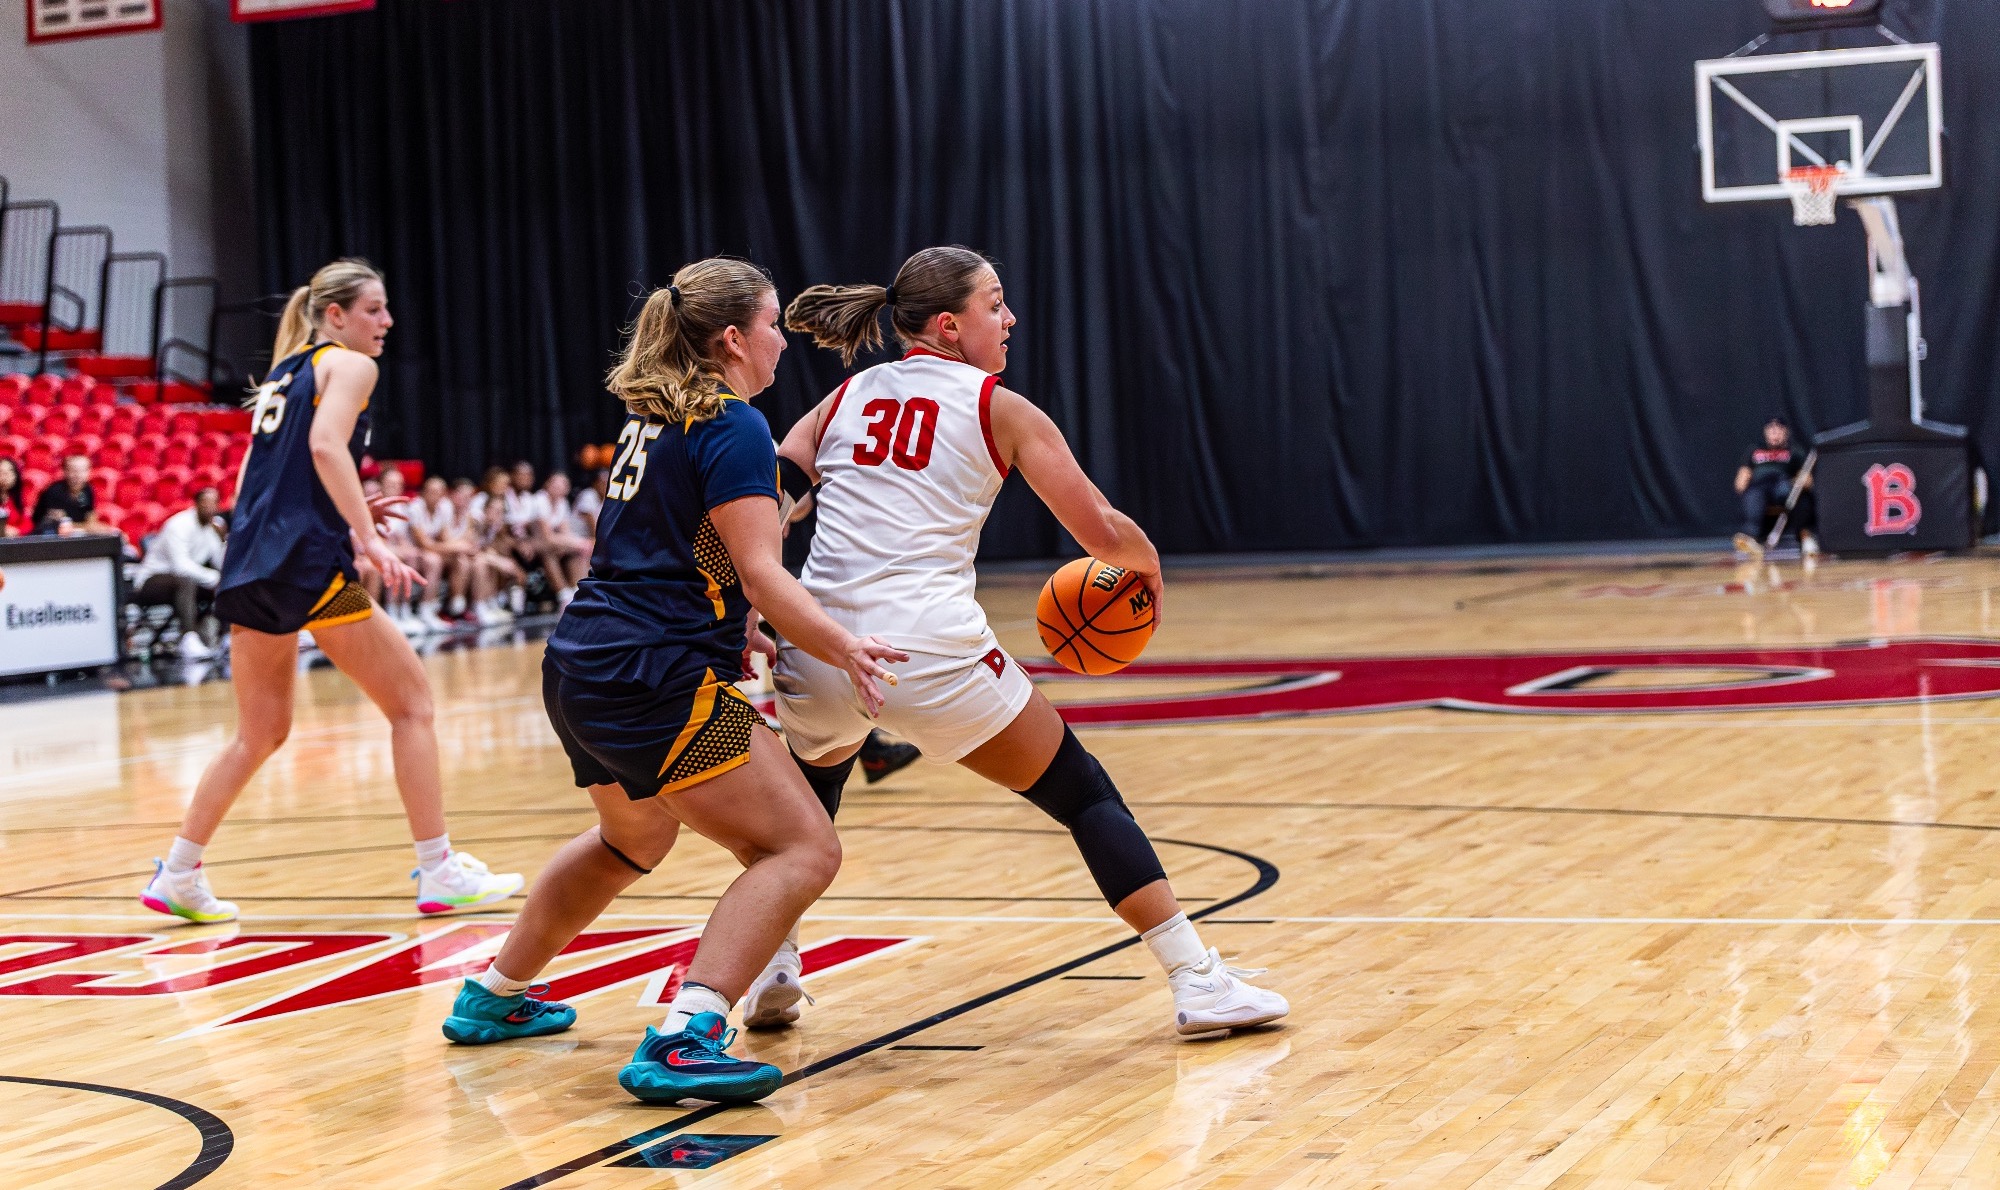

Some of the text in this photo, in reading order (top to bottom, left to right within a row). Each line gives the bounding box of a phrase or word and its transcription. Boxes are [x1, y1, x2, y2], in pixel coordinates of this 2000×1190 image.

[606, 419, 665, 502] 25
[852, 396, 940, 471] 30
[1861, 462, 1922, 537] B
[1091, 566, 1126, 592] Wi
